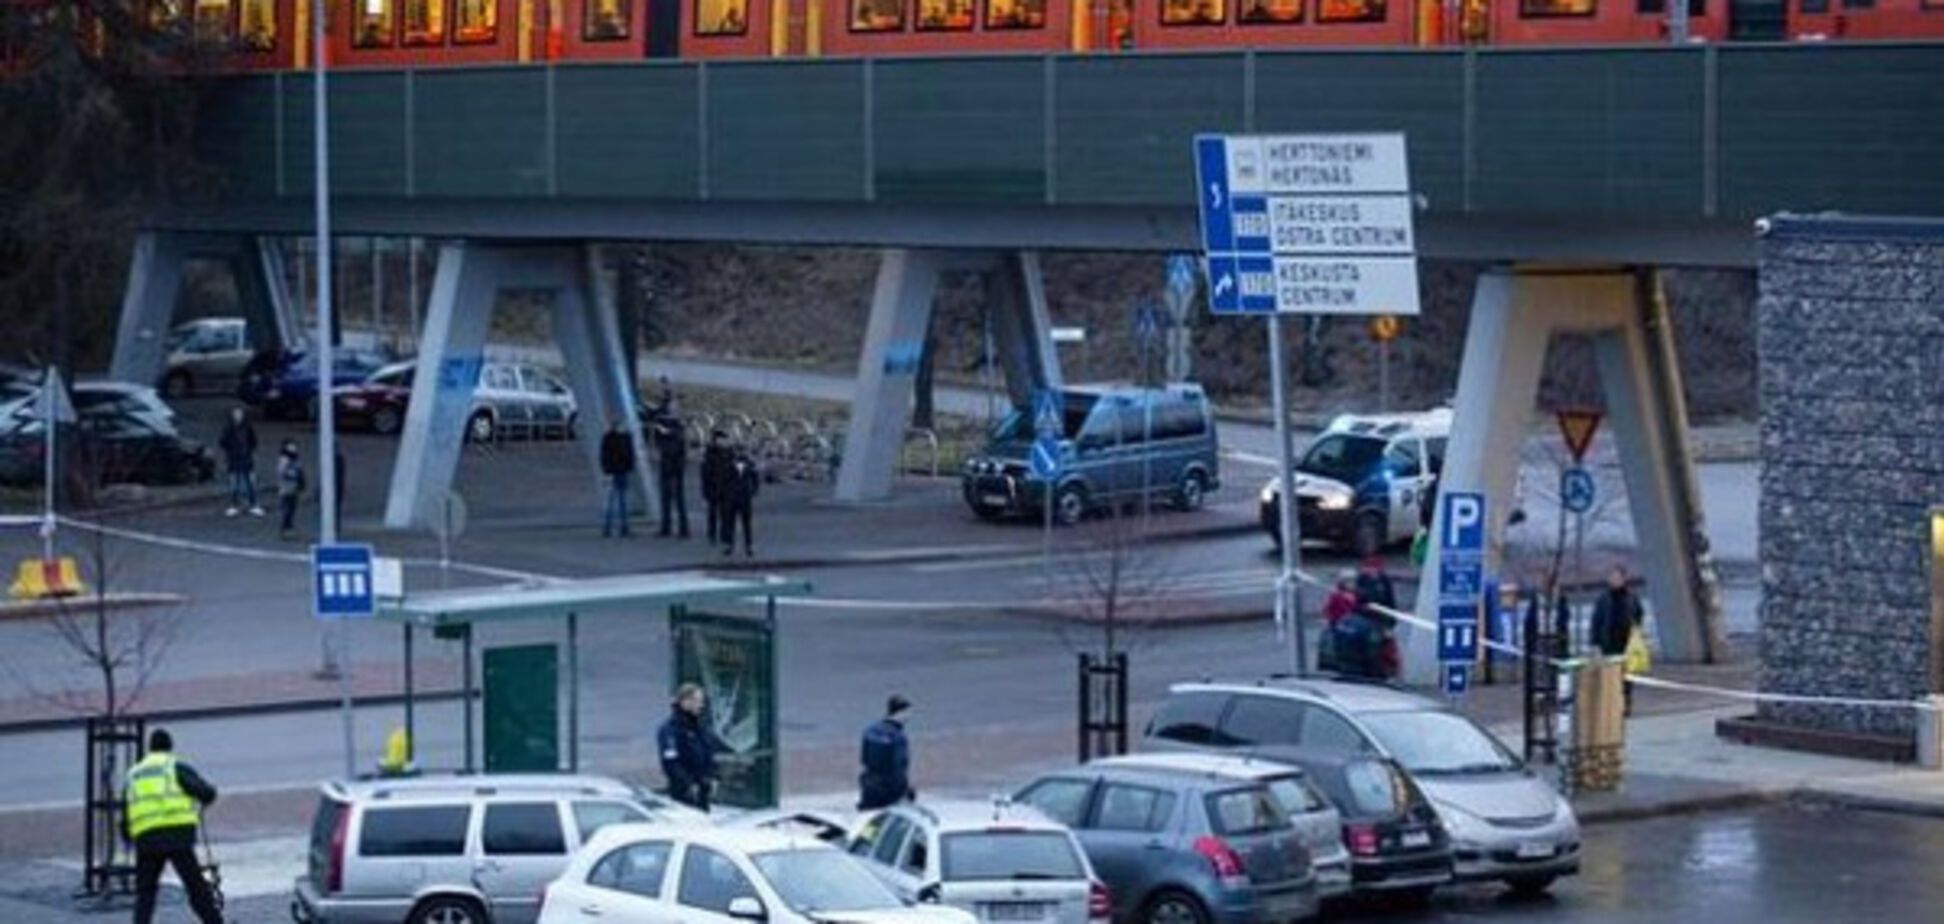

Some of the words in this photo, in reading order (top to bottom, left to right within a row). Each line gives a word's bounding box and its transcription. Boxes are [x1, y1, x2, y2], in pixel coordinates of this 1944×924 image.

[1332, 227, 1406, 246] CENTRUM
[1279, 264, 1359, 283] KESKUSTA
[1282, 287, 1357, 306] CENTRUM
[1451, 497, 1480, 546] P
